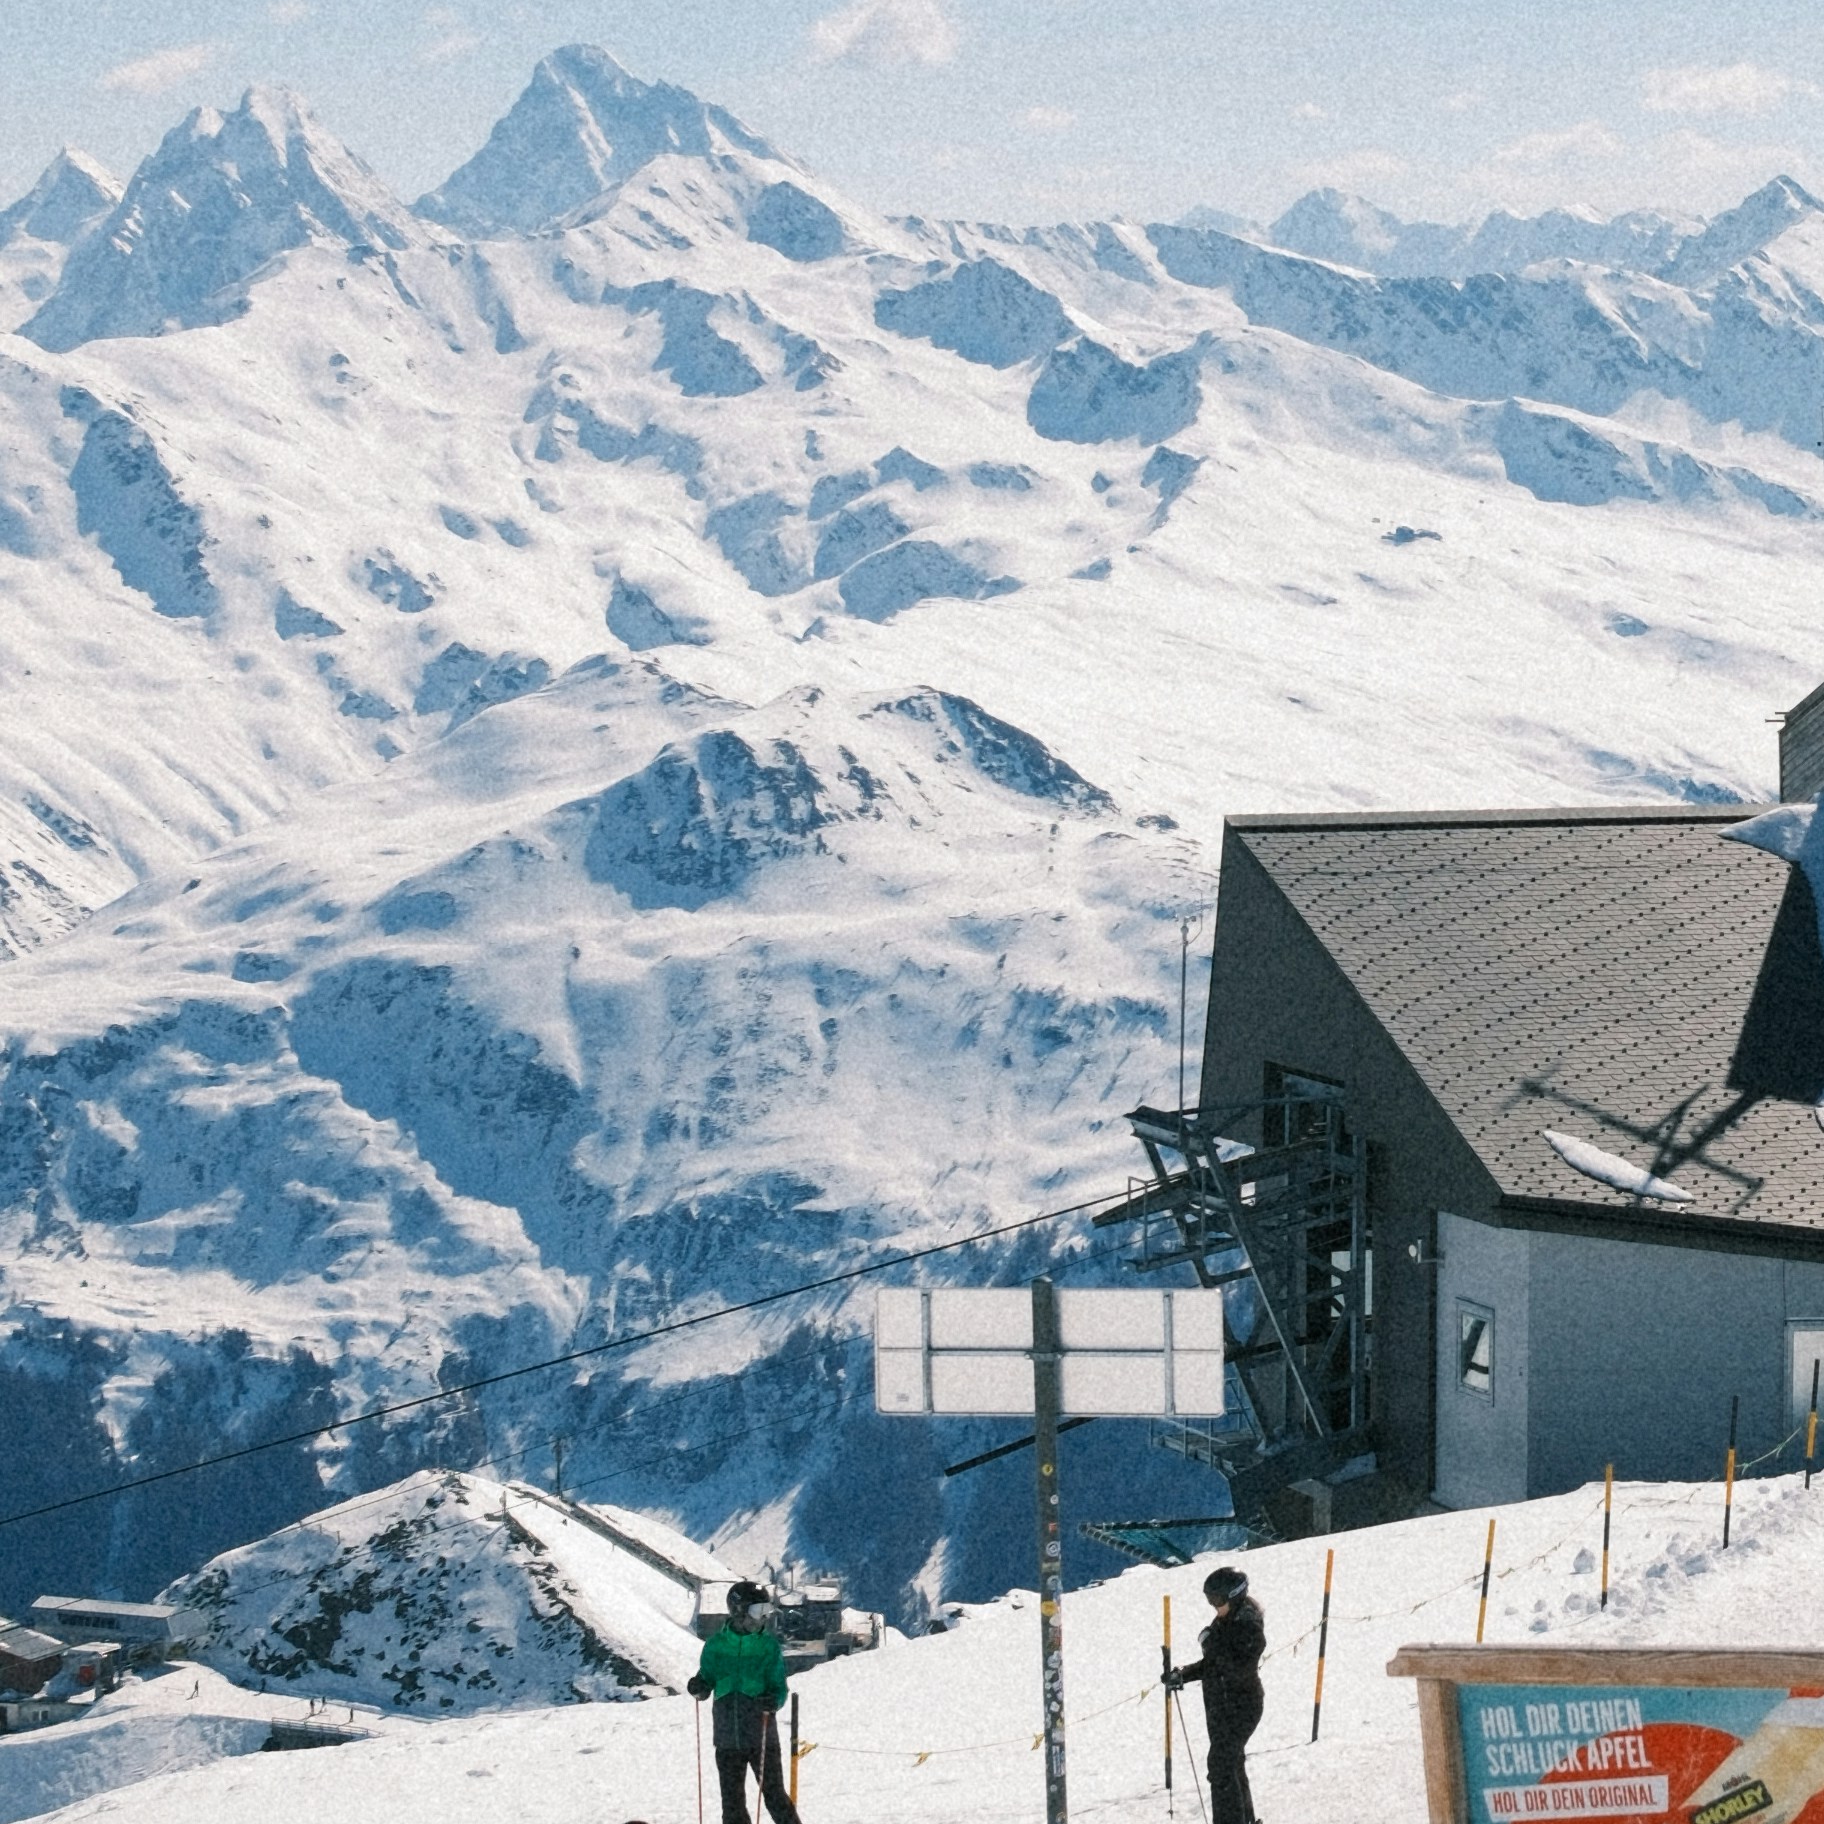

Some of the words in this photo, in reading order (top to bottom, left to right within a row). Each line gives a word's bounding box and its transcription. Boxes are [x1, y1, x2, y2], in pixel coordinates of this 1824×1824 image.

[1481, 1706, 1523, 1739] HOL
[1525, 1702, 1563, 1737] DIR
[1566, 1698, 1643, 1734] DEINEN
[1485, 1740, 1583, 1775] SCHLUCK
[1587, 1735, 1652, 1771] APFEL
[1493, 1792, 1521, 1813] HOL
[1524, 1790, 1549, 1811] DIR
[1552, 1788, 1585, 1811] DEIN
[1588, 1783, 1658, 1809] ORIGINAL
